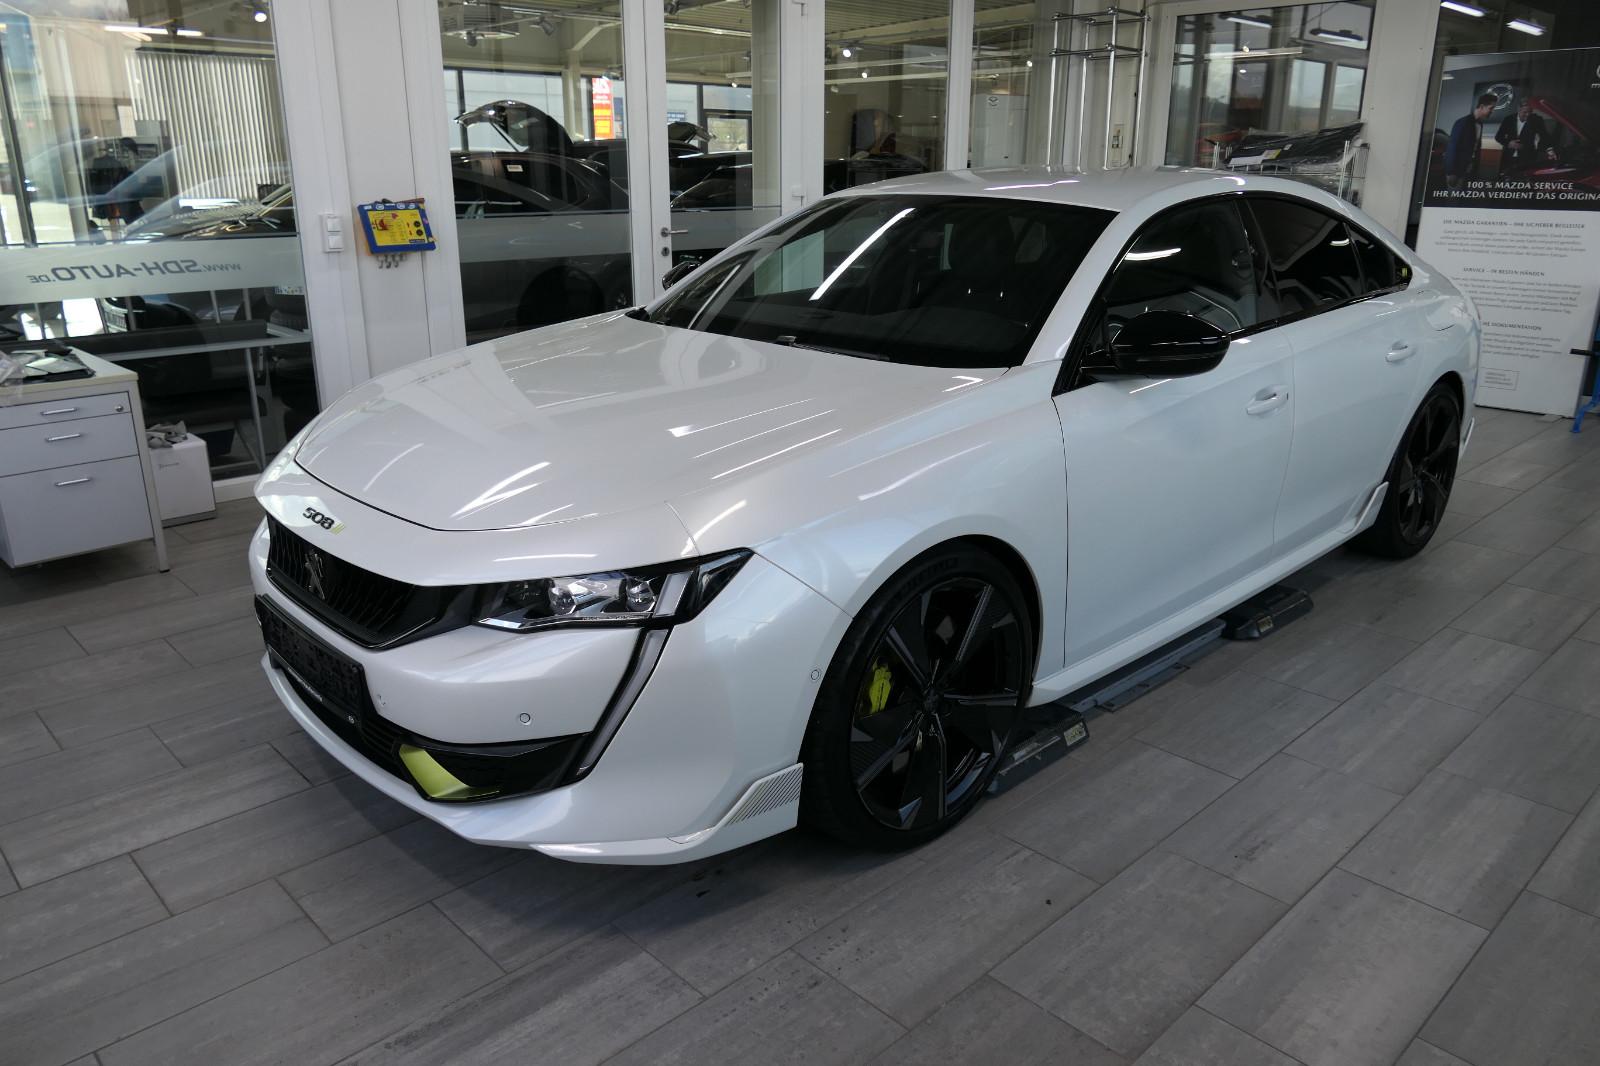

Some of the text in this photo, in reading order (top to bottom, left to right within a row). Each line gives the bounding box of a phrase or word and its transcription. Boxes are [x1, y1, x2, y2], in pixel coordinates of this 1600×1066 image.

[1467, 181, 1483, 189] 100
[1495, 181, 1531, 189] MAZDA
[1534, 182, 1574, 190] SERVICE
[1432, 190, 1449, 198] IHR
[1488, 191, 1534, 199] VERDIENT
[1536, 192, 1556, 200] DAS
[302, 506, 335, 530] 508
